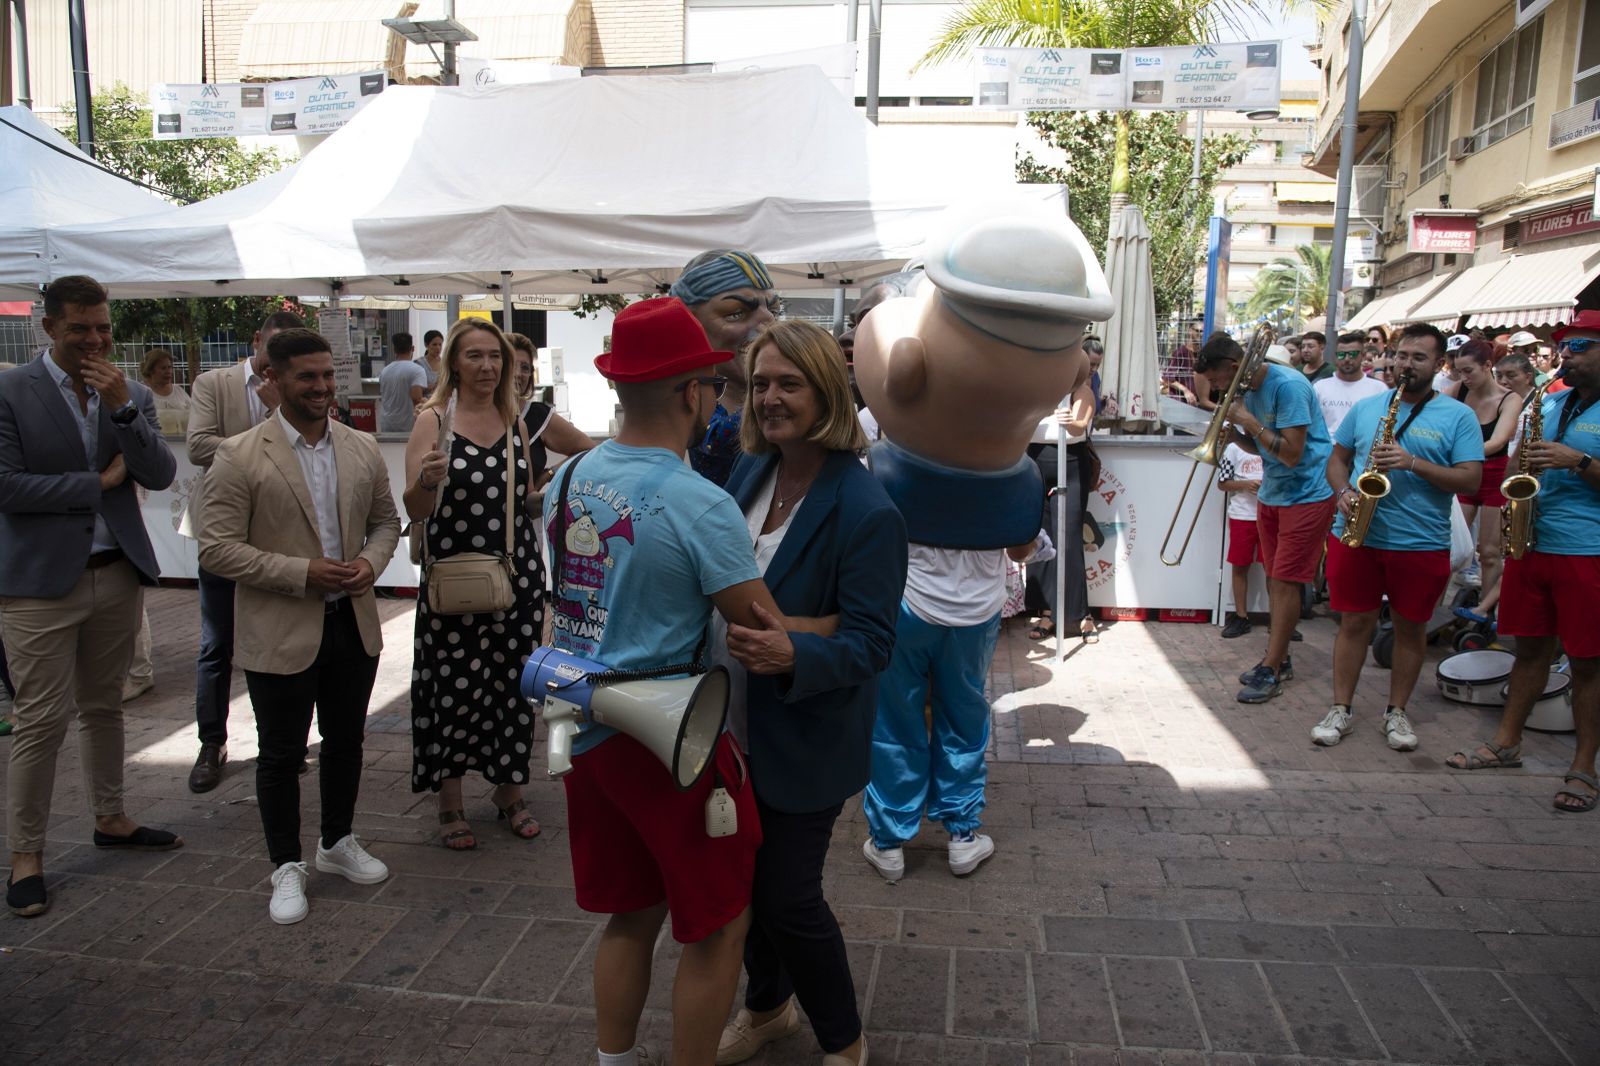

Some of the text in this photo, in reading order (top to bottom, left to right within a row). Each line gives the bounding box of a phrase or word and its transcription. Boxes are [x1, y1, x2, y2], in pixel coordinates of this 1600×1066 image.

[1180, 60, 1232, 70] OUTLET
[1024, 66, 1075, 75] OUTLET
[1174, 73, 1238, 83] CERAMICA
[308, 91, 349, 103] OUTLET
[190, 100, 230, 109] OUTLET
[303, 101, 356, 114] CERAMICA
[1574, 128, 1583, 138] de
[1531, 213, 1575, 235] FLORES
[1432, 231, 1472, 239] FLORES
[1430, 239, 1471, 247] CORREA
[1129, 527, 1137, 541] EN
